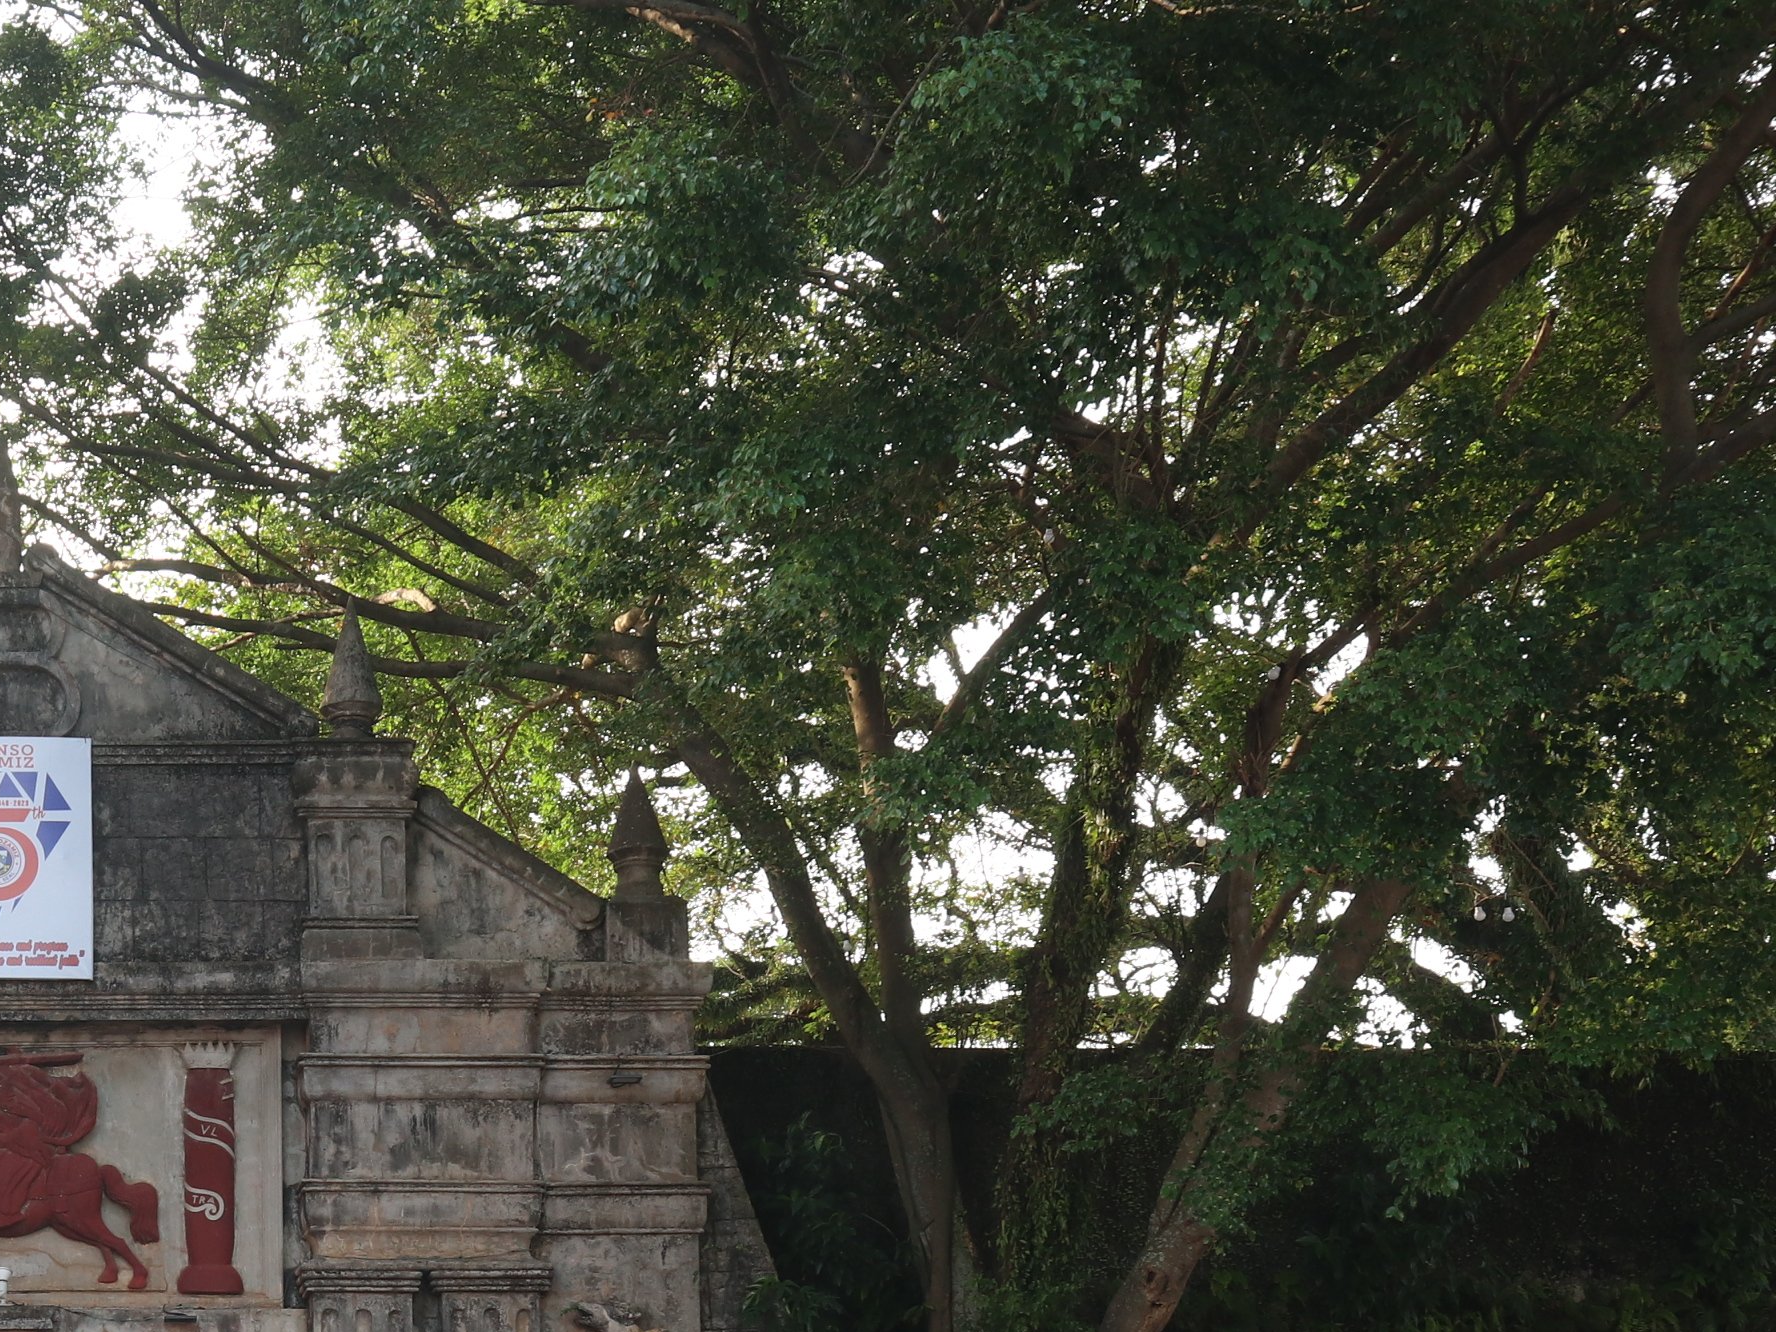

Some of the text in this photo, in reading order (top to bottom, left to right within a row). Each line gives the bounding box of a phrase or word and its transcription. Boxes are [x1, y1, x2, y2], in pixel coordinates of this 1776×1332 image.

[15, 939, 32, 951] and
[6, 954, 23, 966] and
[200, 1124, 218, 1137] VL
